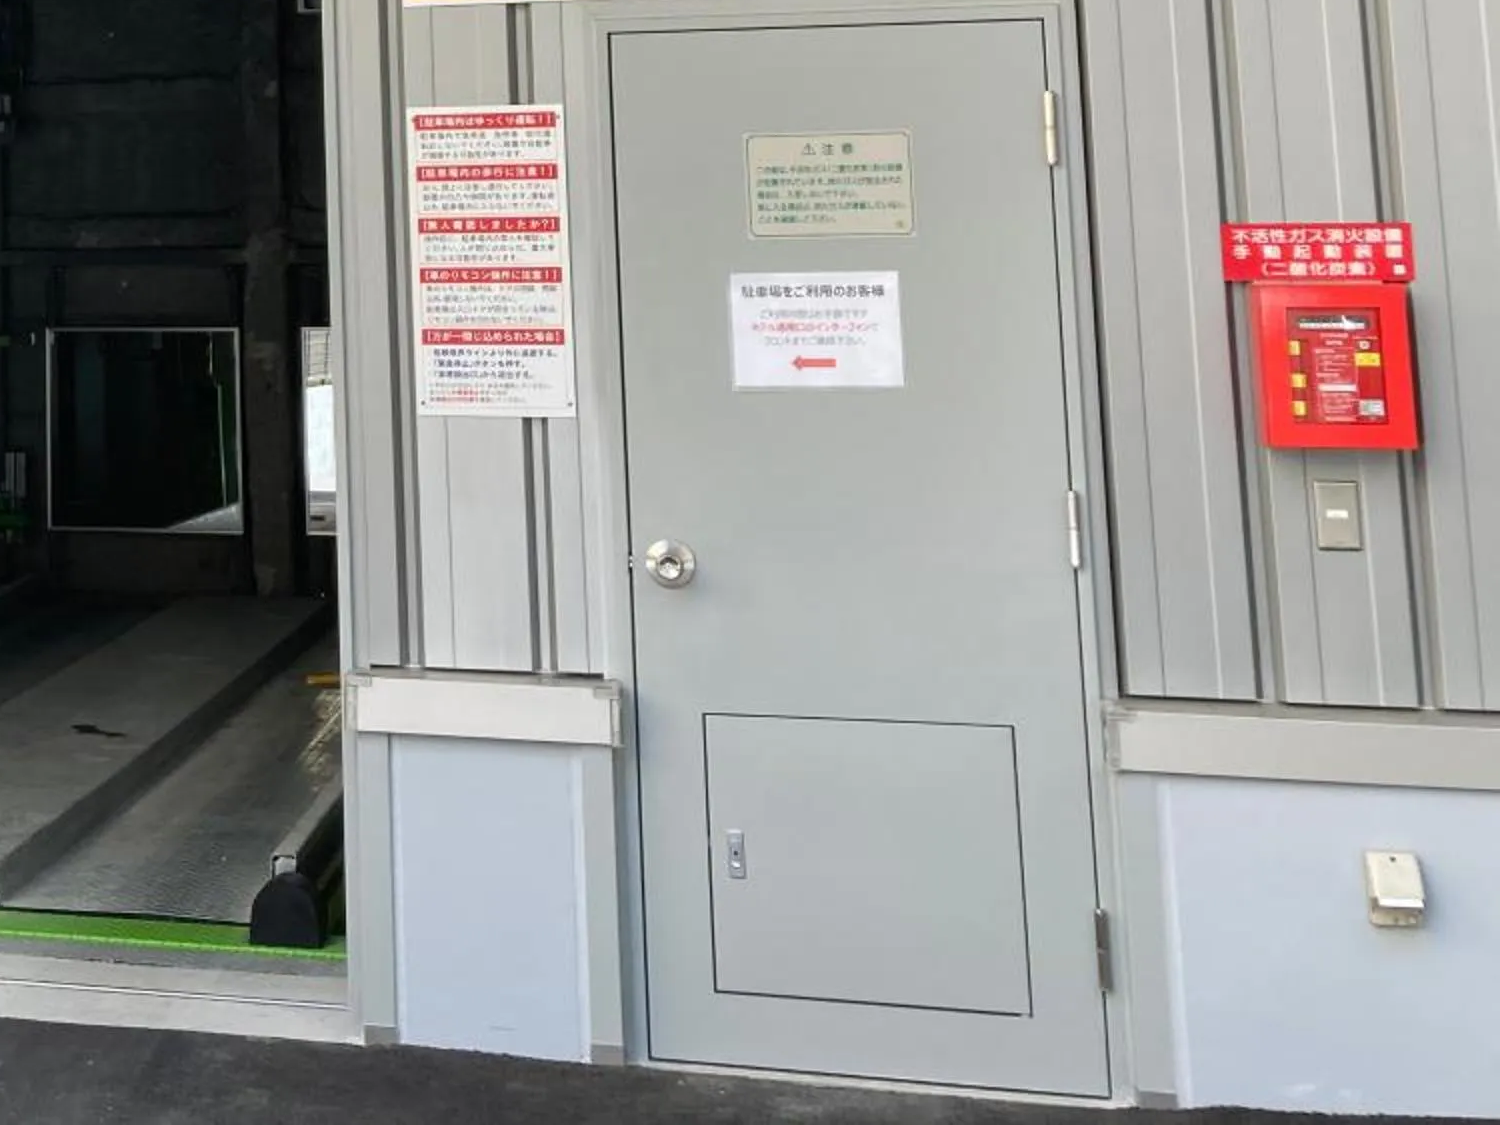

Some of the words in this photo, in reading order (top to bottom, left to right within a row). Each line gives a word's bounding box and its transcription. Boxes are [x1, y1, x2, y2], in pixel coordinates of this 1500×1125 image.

[1231, 228, 1403, 244] 不活性ガス消火設備
[741, 284, 885, 298] 駐車場をご利用のお客様
